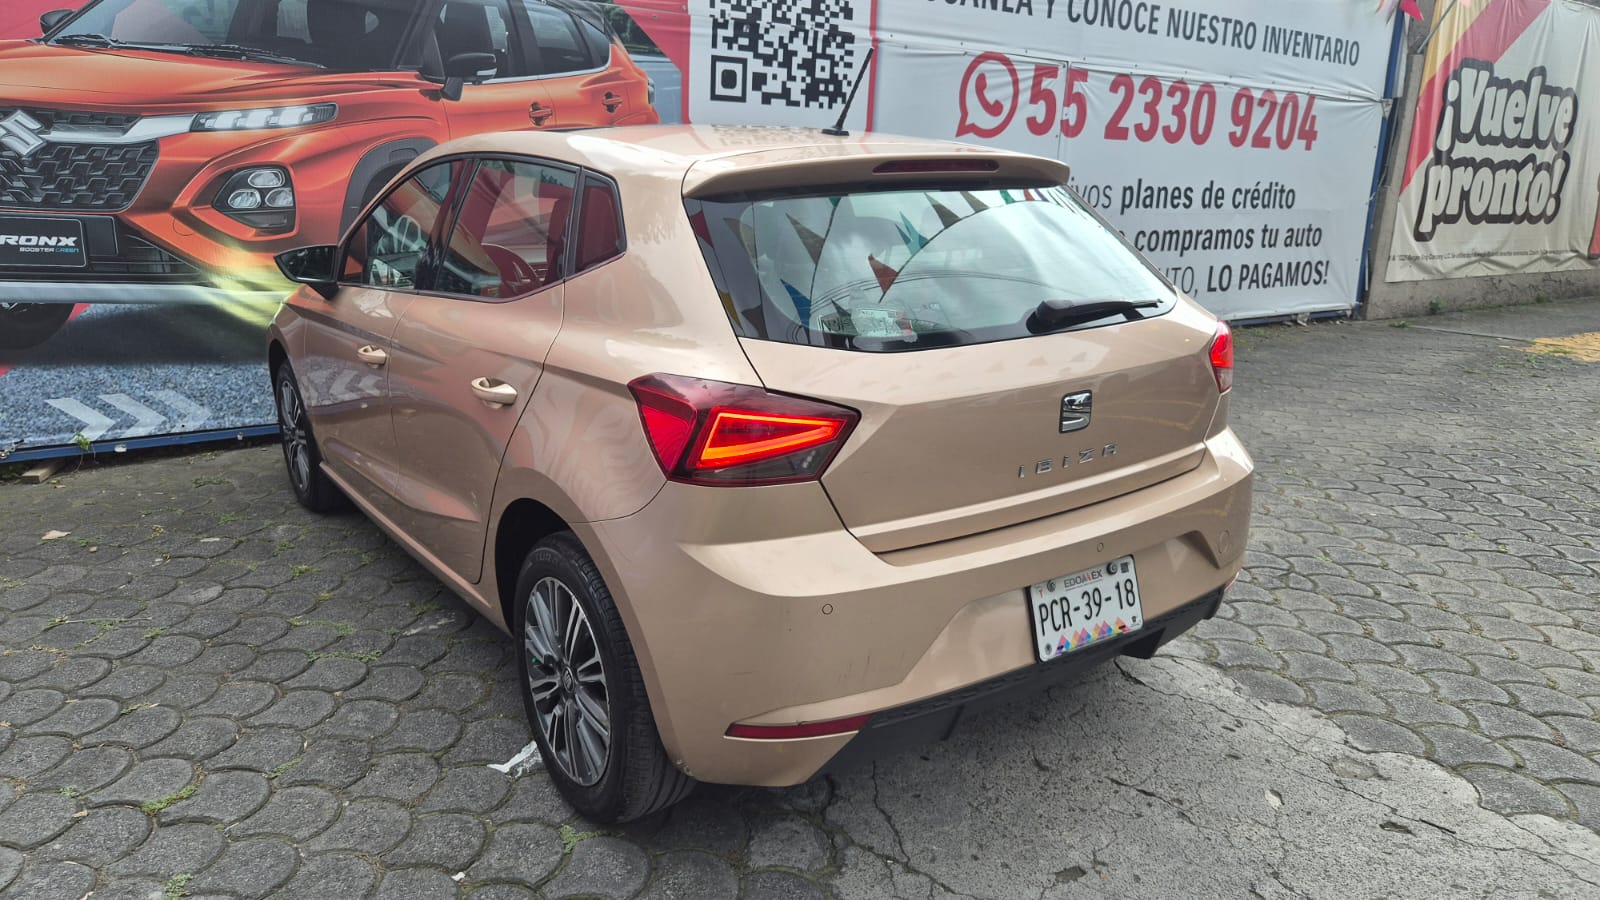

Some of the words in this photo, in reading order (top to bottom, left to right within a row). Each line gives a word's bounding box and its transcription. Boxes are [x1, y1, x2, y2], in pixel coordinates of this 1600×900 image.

[1067, 0, 1161, 35] CONOCE
[1166, 8, 1257, 51] NUESTRO
[1262, 25, 1360, 67] INVENTARIO
[1026, 64, 1089, 138] 55
[1104, 73, 1217, 145] 2330
[1229, 87, 1318, 151] 9204
[1435, 60, 1576, 154] ¡Vuelve
[1120, 178, 1194, 215] planes
[1201, 180, 1225, 209] de
[1231, 181, 1296, 209] crédito
[1415, 154, 1569, 240] pronto!
[0, 234, 78, 247] RONX
[1134, 229, 1254, 257] compramos
[1261, 224, 1279, 249] tu
[1283, 223, 1323, 247] auto
[1206, 264, 1233, 292] LO
[1238, 260, 1330, 290] PAGAMOS!
[1018, 443, 1118, 479] IBIZA
[1038, 578, 1137, 637] PCR-39-18
